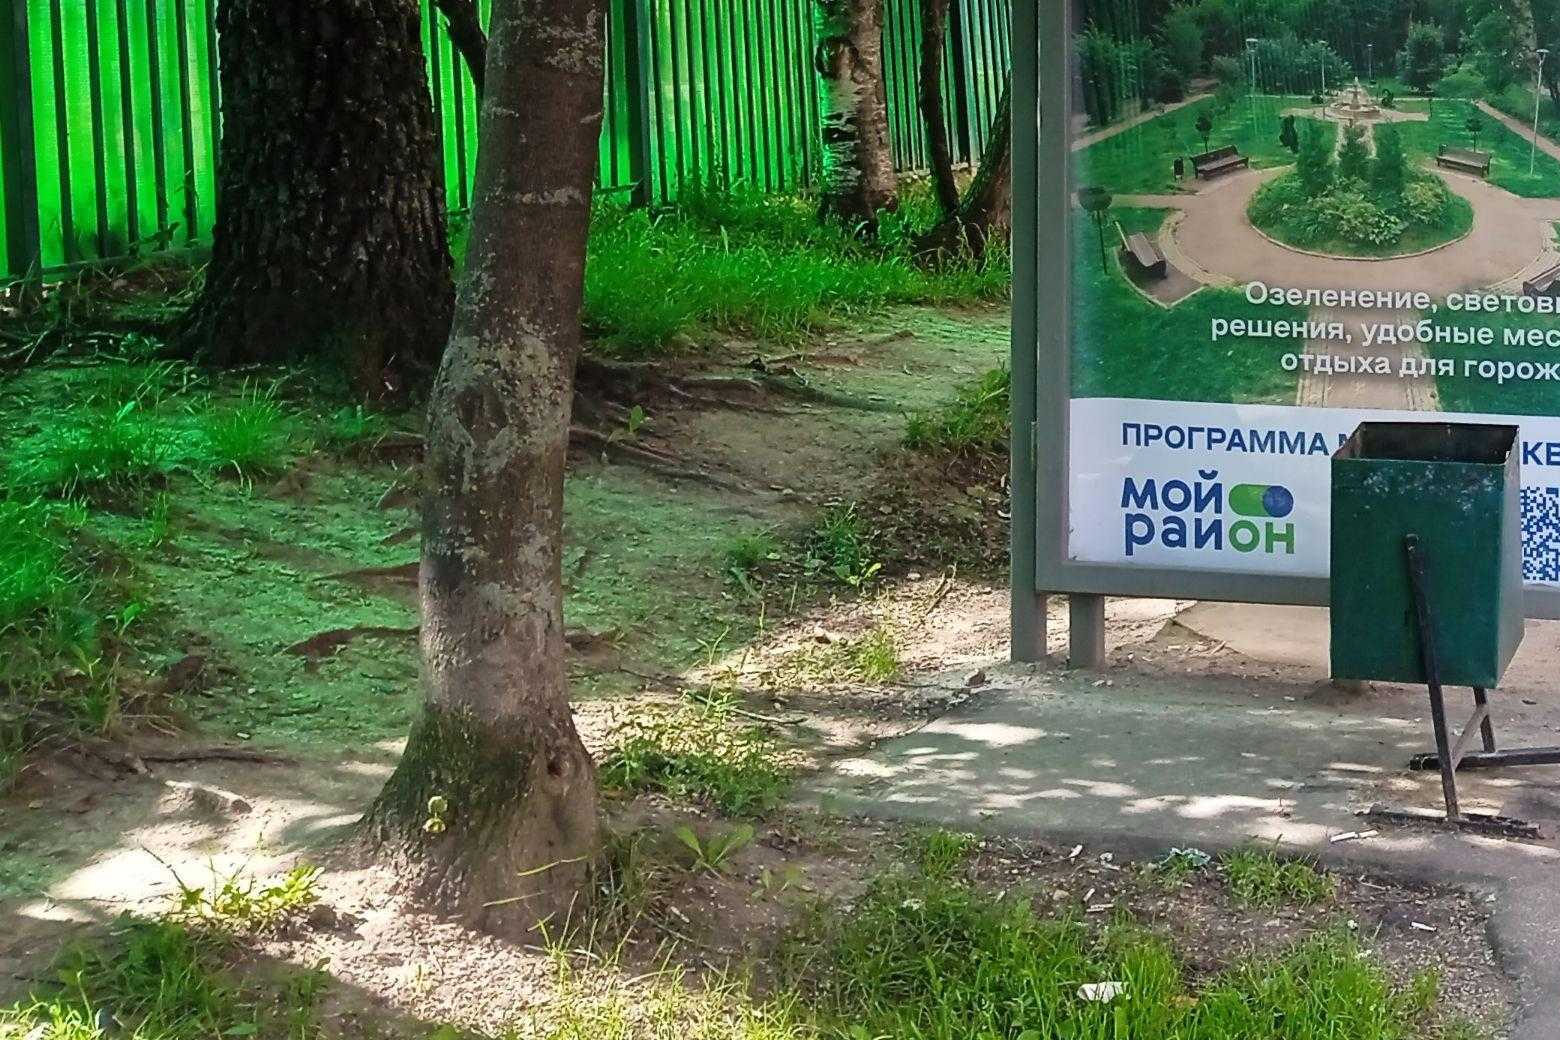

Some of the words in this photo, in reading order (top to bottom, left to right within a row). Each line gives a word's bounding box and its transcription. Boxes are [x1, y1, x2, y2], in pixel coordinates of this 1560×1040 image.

[1245, 281, 1437, 313] Озеленение,
[1211, 317, 1352, 343] решения,
[1360, 319, 1494, 346] удобные
[1281, 350, 1391, 375] отдыха
[1399, 356, 1455, 378] для
[1122, 422, 1329, 456] ПРОГРАММА
[1121, 469, 1223, 514] мой
